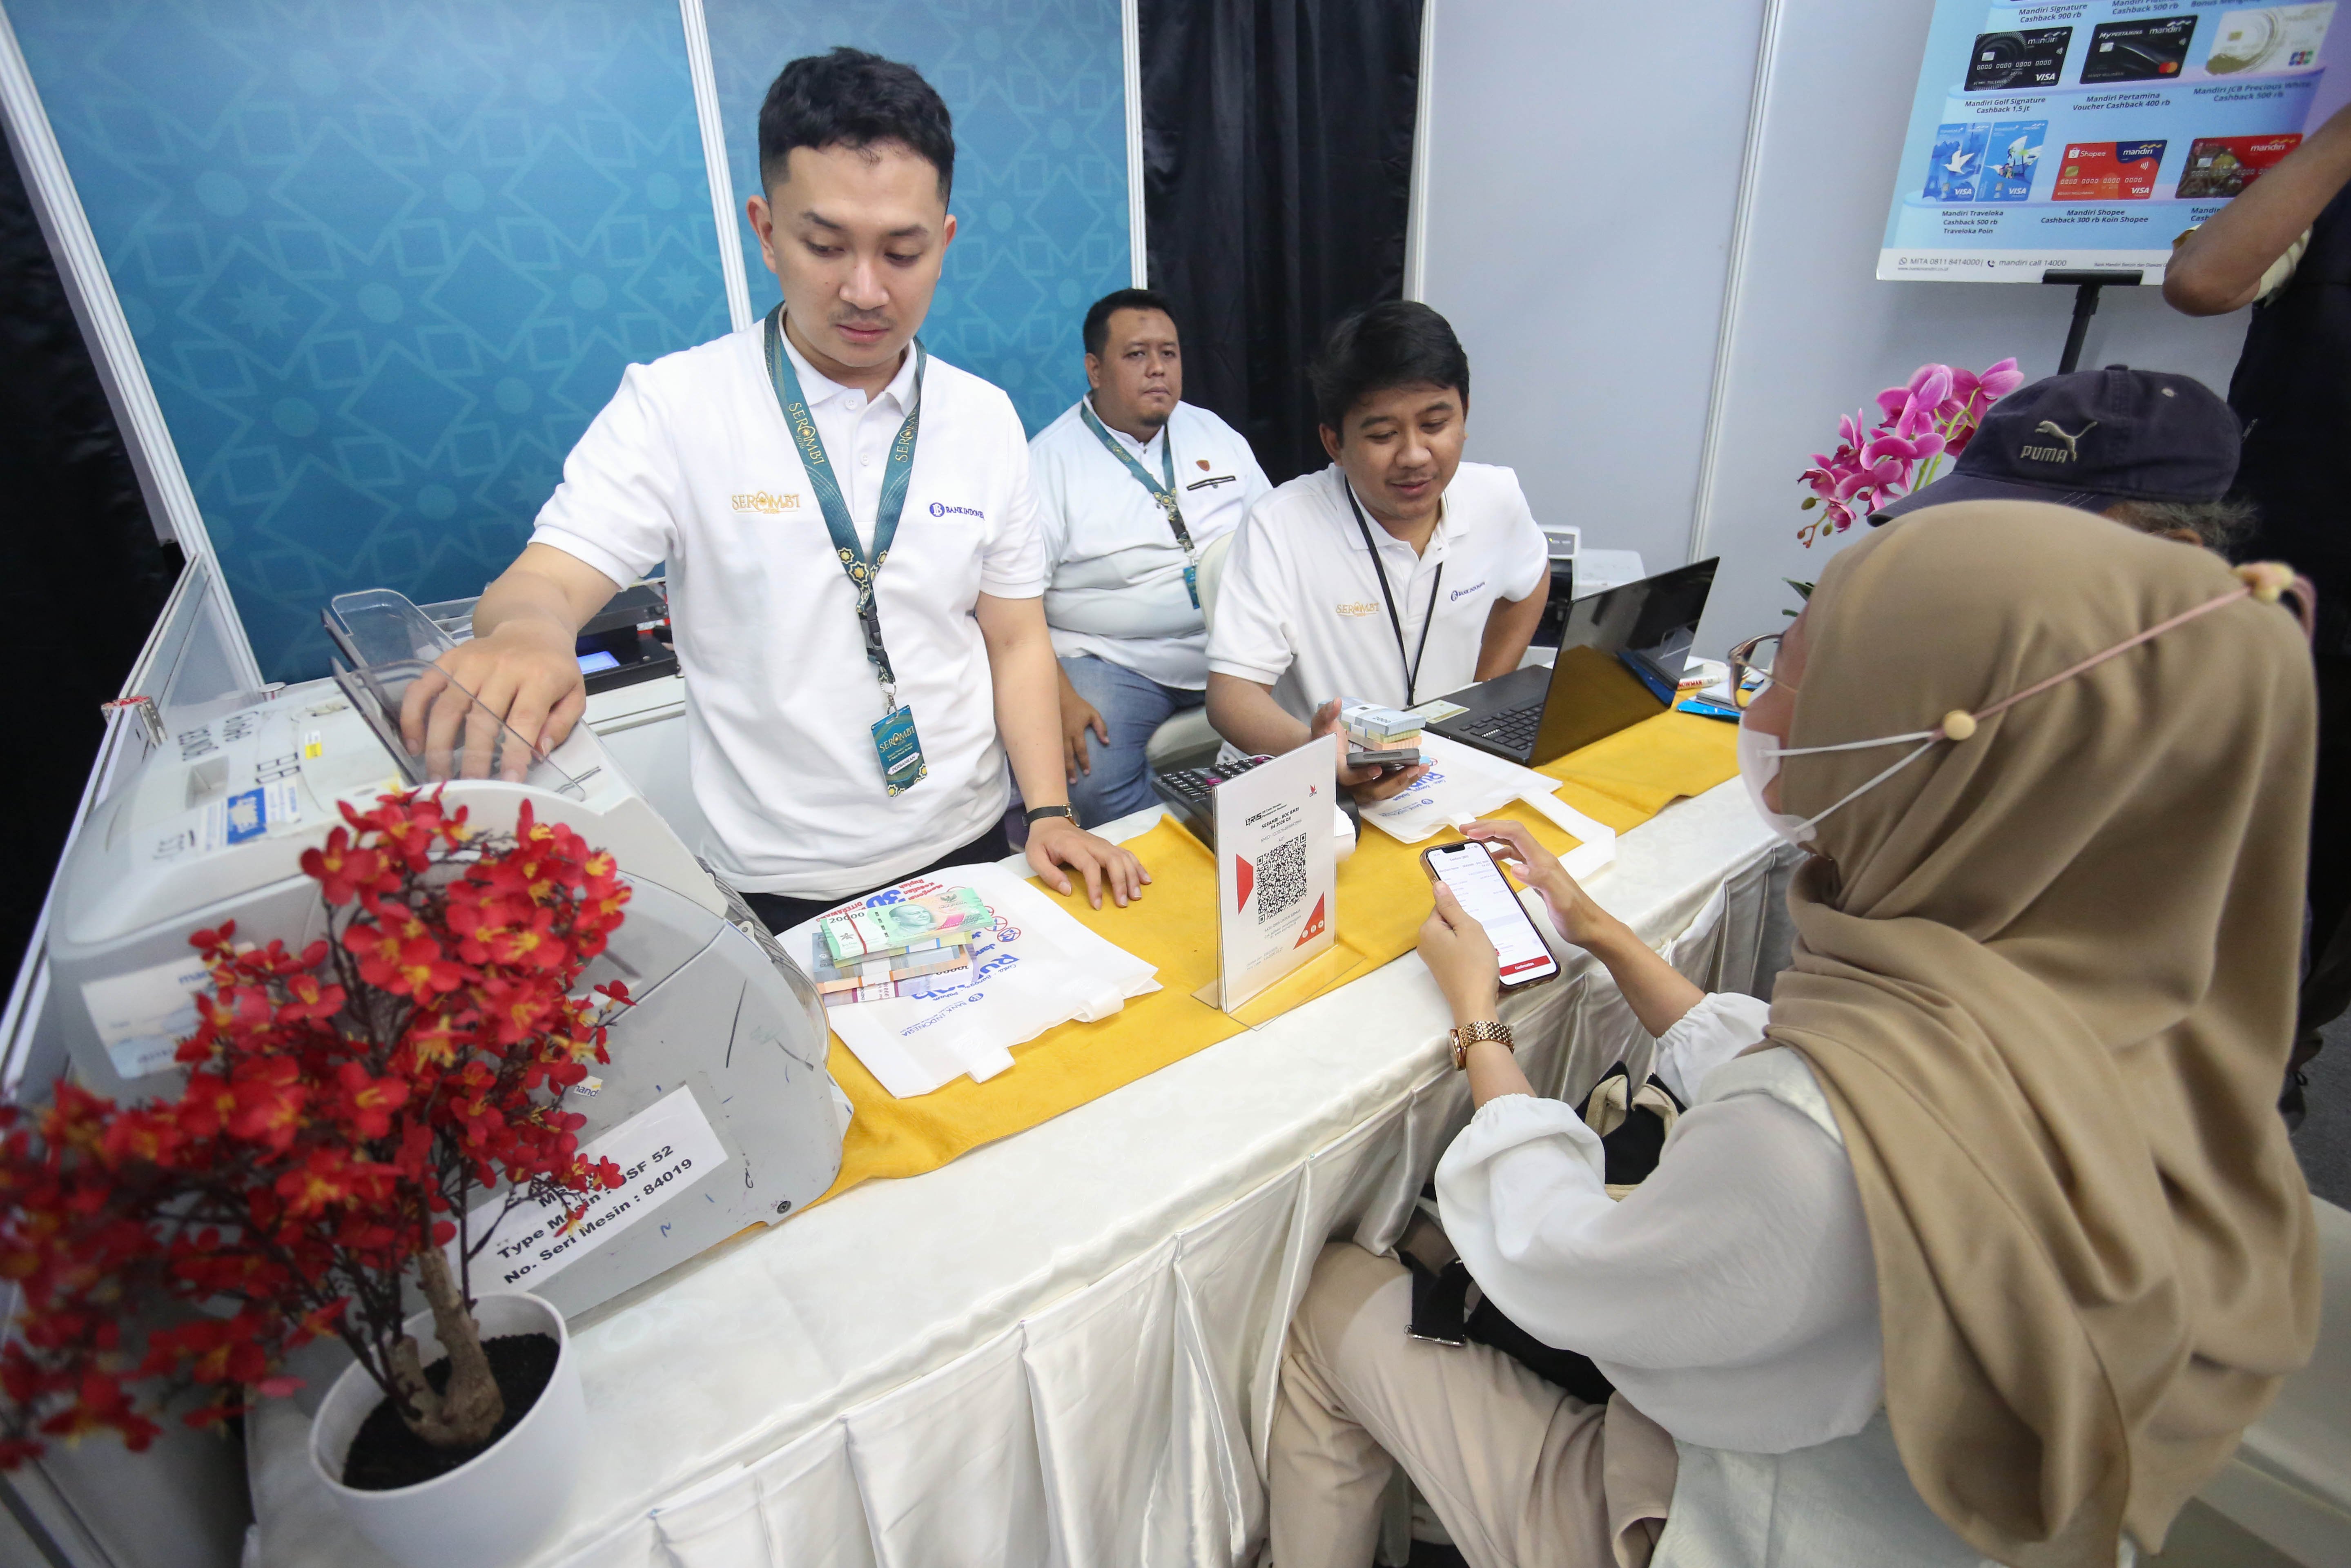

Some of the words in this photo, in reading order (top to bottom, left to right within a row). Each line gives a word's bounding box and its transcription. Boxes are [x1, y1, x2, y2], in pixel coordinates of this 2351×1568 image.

[2019, 7, 2048, 15] Mandiri
[2050, 3, 2087, 13] Signature
[2112, 6, 2150, 15] Cashback
[2020, 13, 2055, 23] Cashback
[2149, 26, 2182, 35] mandiri
[2035, 73, 2055, 81] VISA
[2228, 85, 2242, 94] JCB
[2246, 83, 2282, 91] Precious
[2118, 92, 2160, 100] Pertamina
[2213, 94, 2253, 102] Cashback
[2106, 101, 2143, 109] Cashback
[2019, 445, 2068, 463] PUMA
[892, 755, 915, 772] PERBANKAN
[1261, 817, 1279, 829] SERAMBI
[1281, 811, 1290, 820] BOC
[1290, 806, 1299, 815] BMRI
[1276, 819, 1286, 827] 2026
[898, 879, 925, 889] Rupiah
[1515, 961, 1535, 971] Confirmation
[946, 1002, 967, 1014] BANK
[901, 1012, 946, 1036] INDONESIA
[497, 1226, 545, 1260] Type
[651, 1145, 674, 1163] 52
[503, 1263, 537, 1285] No.
[539, 1235, 576, 1261] Seri
[578, 1199, 631, 1238] Mesin
[642, 1158, 693, 1196] 84019
